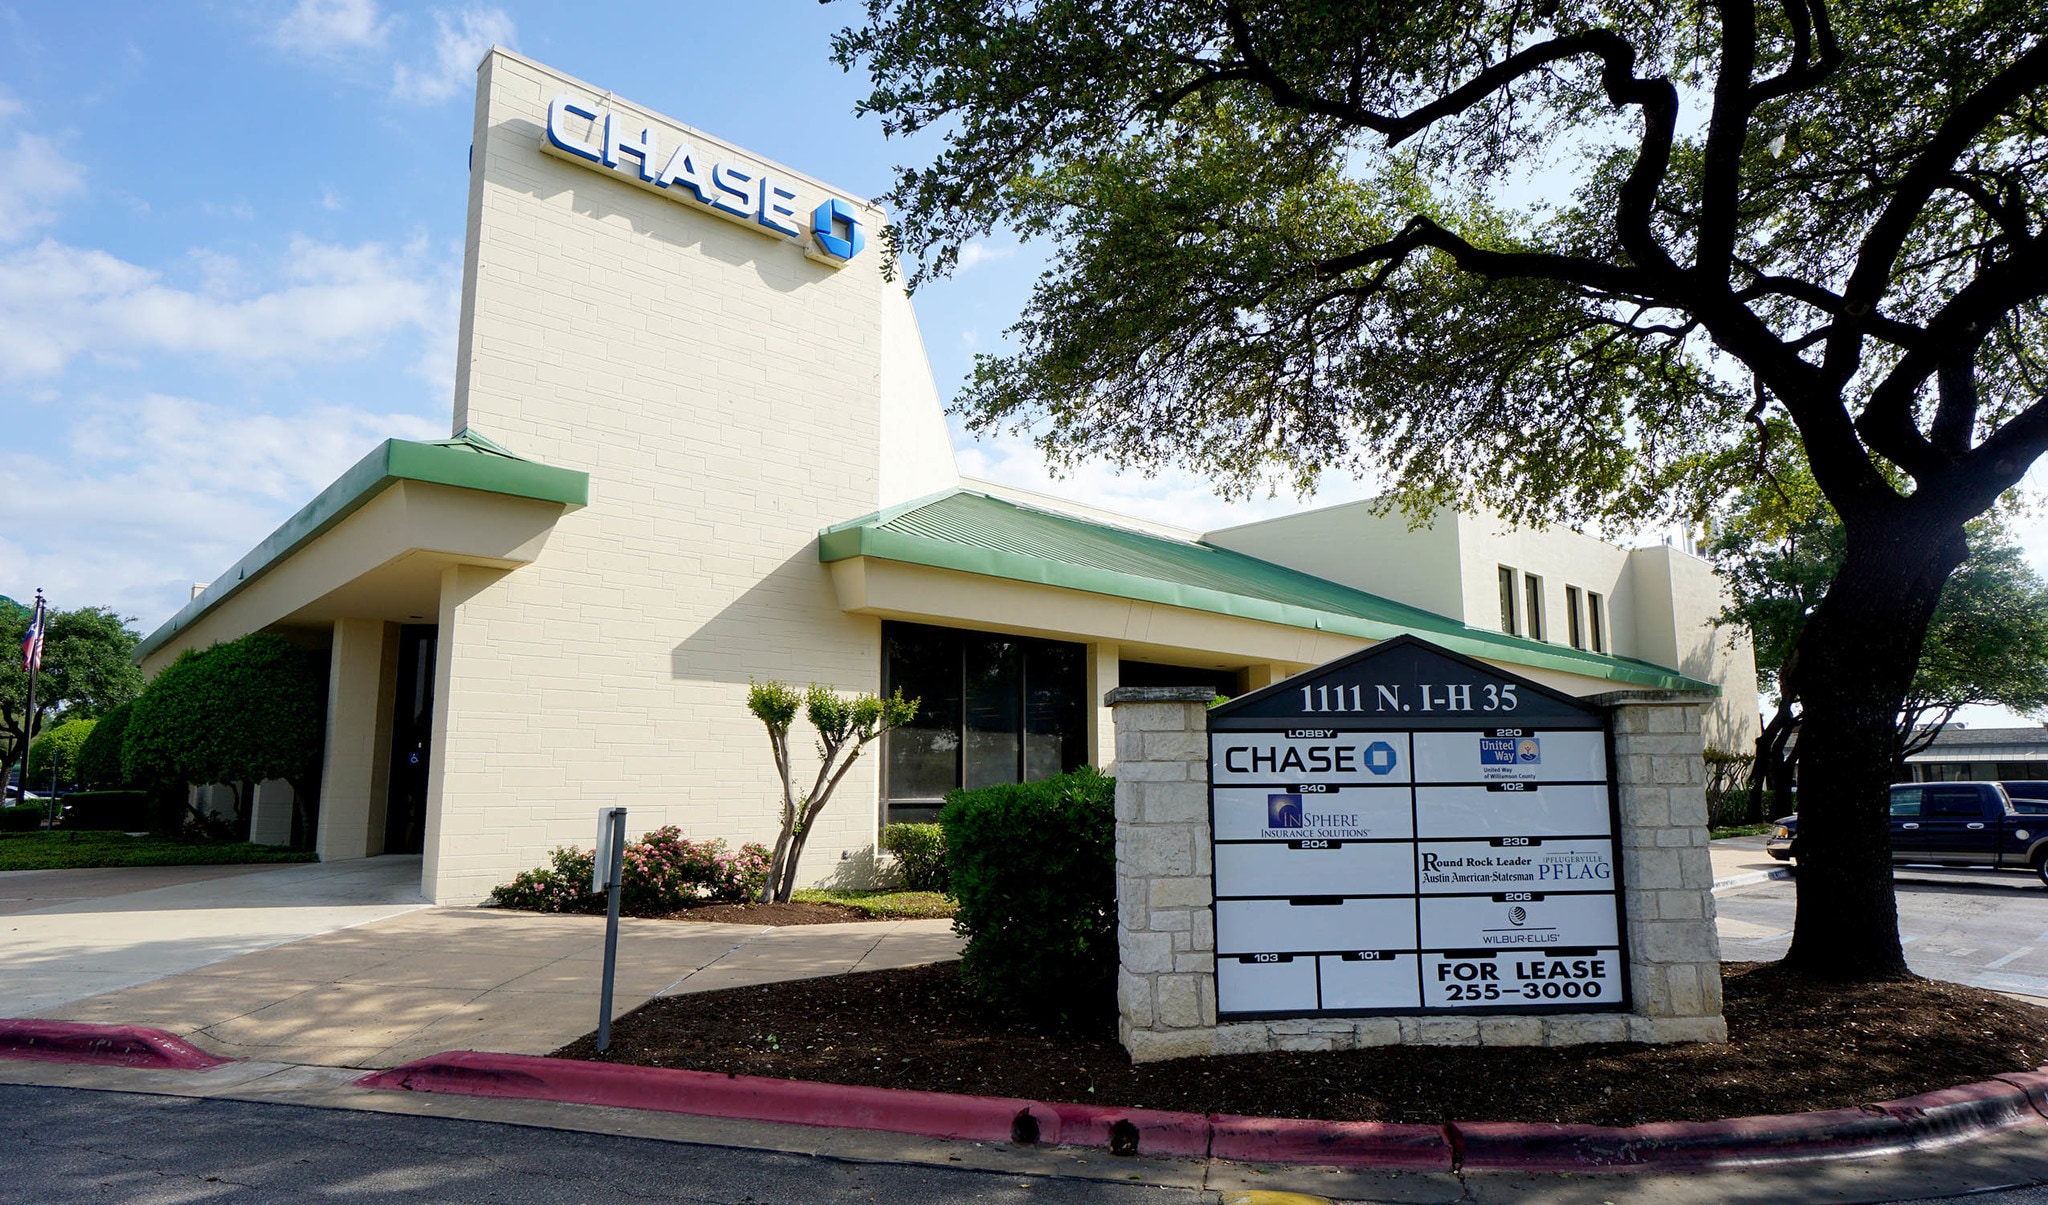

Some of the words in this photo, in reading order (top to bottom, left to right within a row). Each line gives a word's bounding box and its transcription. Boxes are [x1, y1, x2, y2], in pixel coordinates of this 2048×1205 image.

[547, 93, 800, 237] CHASE
[1300, 684, 1364, 712] 1111
[1375, 684, 1410, 712] N.
[1419, 684, 1475, 711] I-H
[1482, 683, 1518, 711] 35
[1288, 729, 1334, 738] LOBBY
[1496, 728, 1523, 737] 220
[1481, 740, 1515, 751] United
[1225, 746, 1358, 773] CHASE
[1494, 751, 1515, 764] Way
[1299, 784, 1327, 793] 240
[1500, 782, 1525, 791] 102
[1261, 829, 1314, 839] INSURANCE
[1301, 840, 1329, 849] 204
[1502, 837, 1529, 846] 230
[1421, 852, 1463, 872] Round
[1466, 856, 1494, 867] Rock
[1496, 856, 1532, 867] Leader
[1538, 862, 1611, 880] PFLAG
[1422, 872, 1451, 884] Austin
[1451, 870, 1535, 884] American-Statesman
[1505, 892, 1532, 901] 206
[1253, 953, 1279, 962] 103
[1358, 951, 1380, 960] 101
[1437, 962, 1500, 981] FOR
[1515, 960, 1606, 980] LEASE
